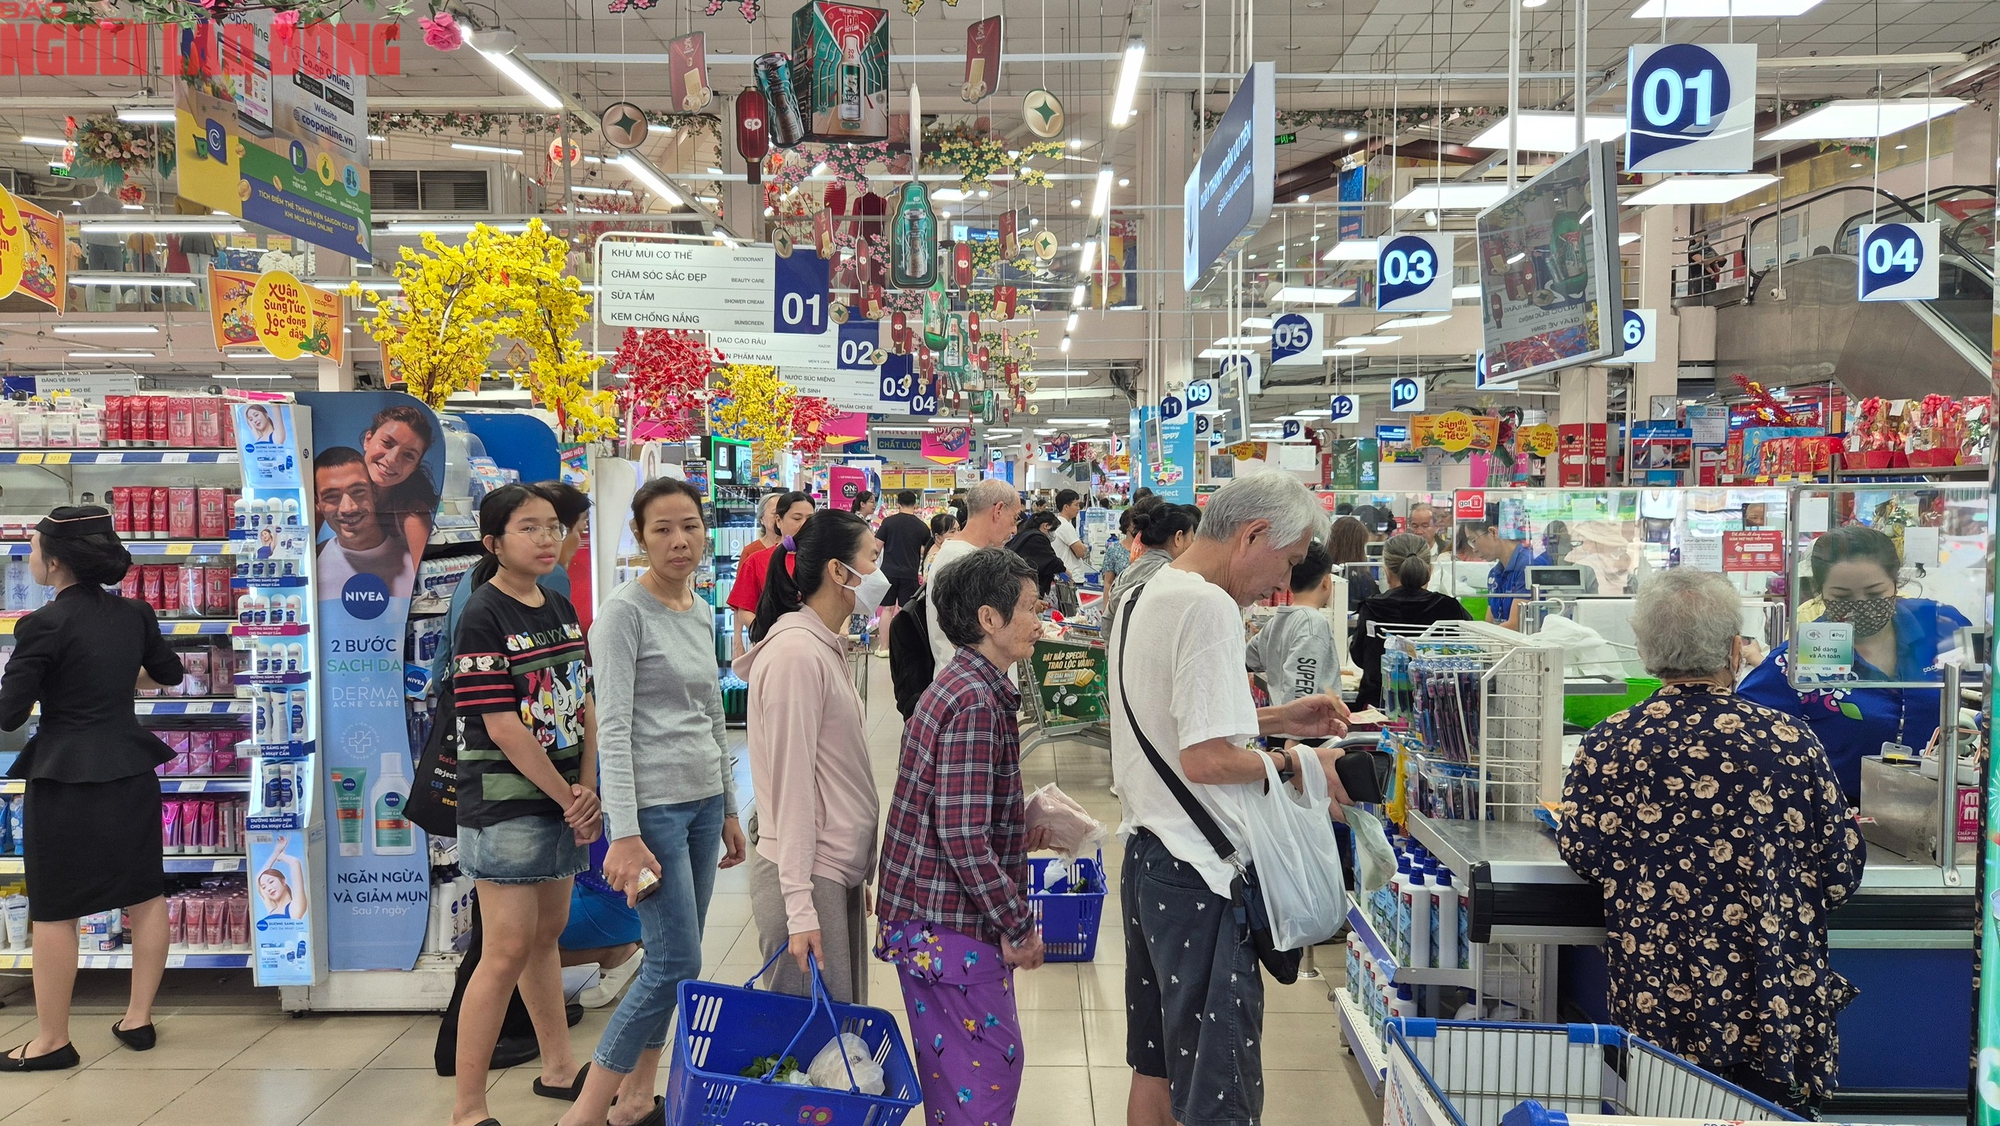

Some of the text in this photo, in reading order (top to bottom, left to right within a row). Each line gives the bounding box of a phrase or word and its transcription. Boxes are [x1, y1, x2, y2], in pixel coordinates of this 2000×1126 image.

[326, 73, 351, 91] Online
[1642, 67, 1712, 127] 01
[313, 102, 338, 122] Website
[301, 114, 354, 147] cooponline.vn
[284, 210, 295, 219] KHI
[294, 213, 306, 224] MUA
[316, 221, 335, 234] ONLINE
[324, 215, 342, 227] SAIGON
[611, 248, 634, 258] KHỬ
[636, 248, 654, 259] MÙI
[655, 249, 672, 260] CƠ
[673, 249, 693, 260] THỂ
[1867, 238, 1919, 275] 04
[1383, 249, 1434, 286] 03
[611, 269, 640, 280] CHĂM
[642, 269, 663, 281] SÓC
[665, 269, 686, 282] SẮC
[687, 271, 708, 283] ĐẸP
[611, 289, 633, 301] SỮA
[634, 289, 655, 302] TẮM
[724, 298, 747, 306] SHOWER
[263, 298, 306, 315] Sung Túc
[781, 292, 821, 326] 01
[263, 312, 307, 337] Lộc đong
[610, 312, 633, 322] KEM
[634, 310, 670, 323] CHỐNG
[672, 311, 700, 324] NẮNG
[716, 336, 733, 345] DAO
[734, 337, 750, 346] CẠO
[751, 336, 767, 346] RÂU
[1275, 323, 1309, 348] 05
[731, 352, 754, 361] PHẨM
[840, 340, 874, 366] 02
[784, 373, 836, 384] NƯỚC SÚC MIỆNG
[882, 376, 910, 398] 03
[1187, 385, 1211, 402] 09
[1394, 383, 1417, 401] 10
[912, 395, 936, 412] 04
[1162, 401, 1179, 415] 11
[1332, 399, 1351, 415] 12
[1284, 423, 1299, 434] 14
[345, 591, 385, 602] NIVEA
[331, 635, 397, 653] 2 BƯỚC
[1812, 645, 1838, 654] Dễ dàng
[1065, 651, 1088, 660] SPECIAL
[327, 658, 402, 677] SẠCH DA
[1047, 658, 1096, 670] TRAO LỘC VÀNG
[406, 677, 426, 687] NIVEA
[1294, 657, 1317, 699] SUPER
[332, 686, 399, 701] DERMA
[333, 700, 400, 708] ACNE CARE
[430, 780, 444, 789] CSS
[441, 797, 458, 807] Html
[250, 816, 268, 824] DƯỠNG
[337, 868, 424, 883] NGĂN NGỪA
[333, 887, 428, 906] VÀ GIẢM MỤN
[352, 906, 380, 916] Sau 7
